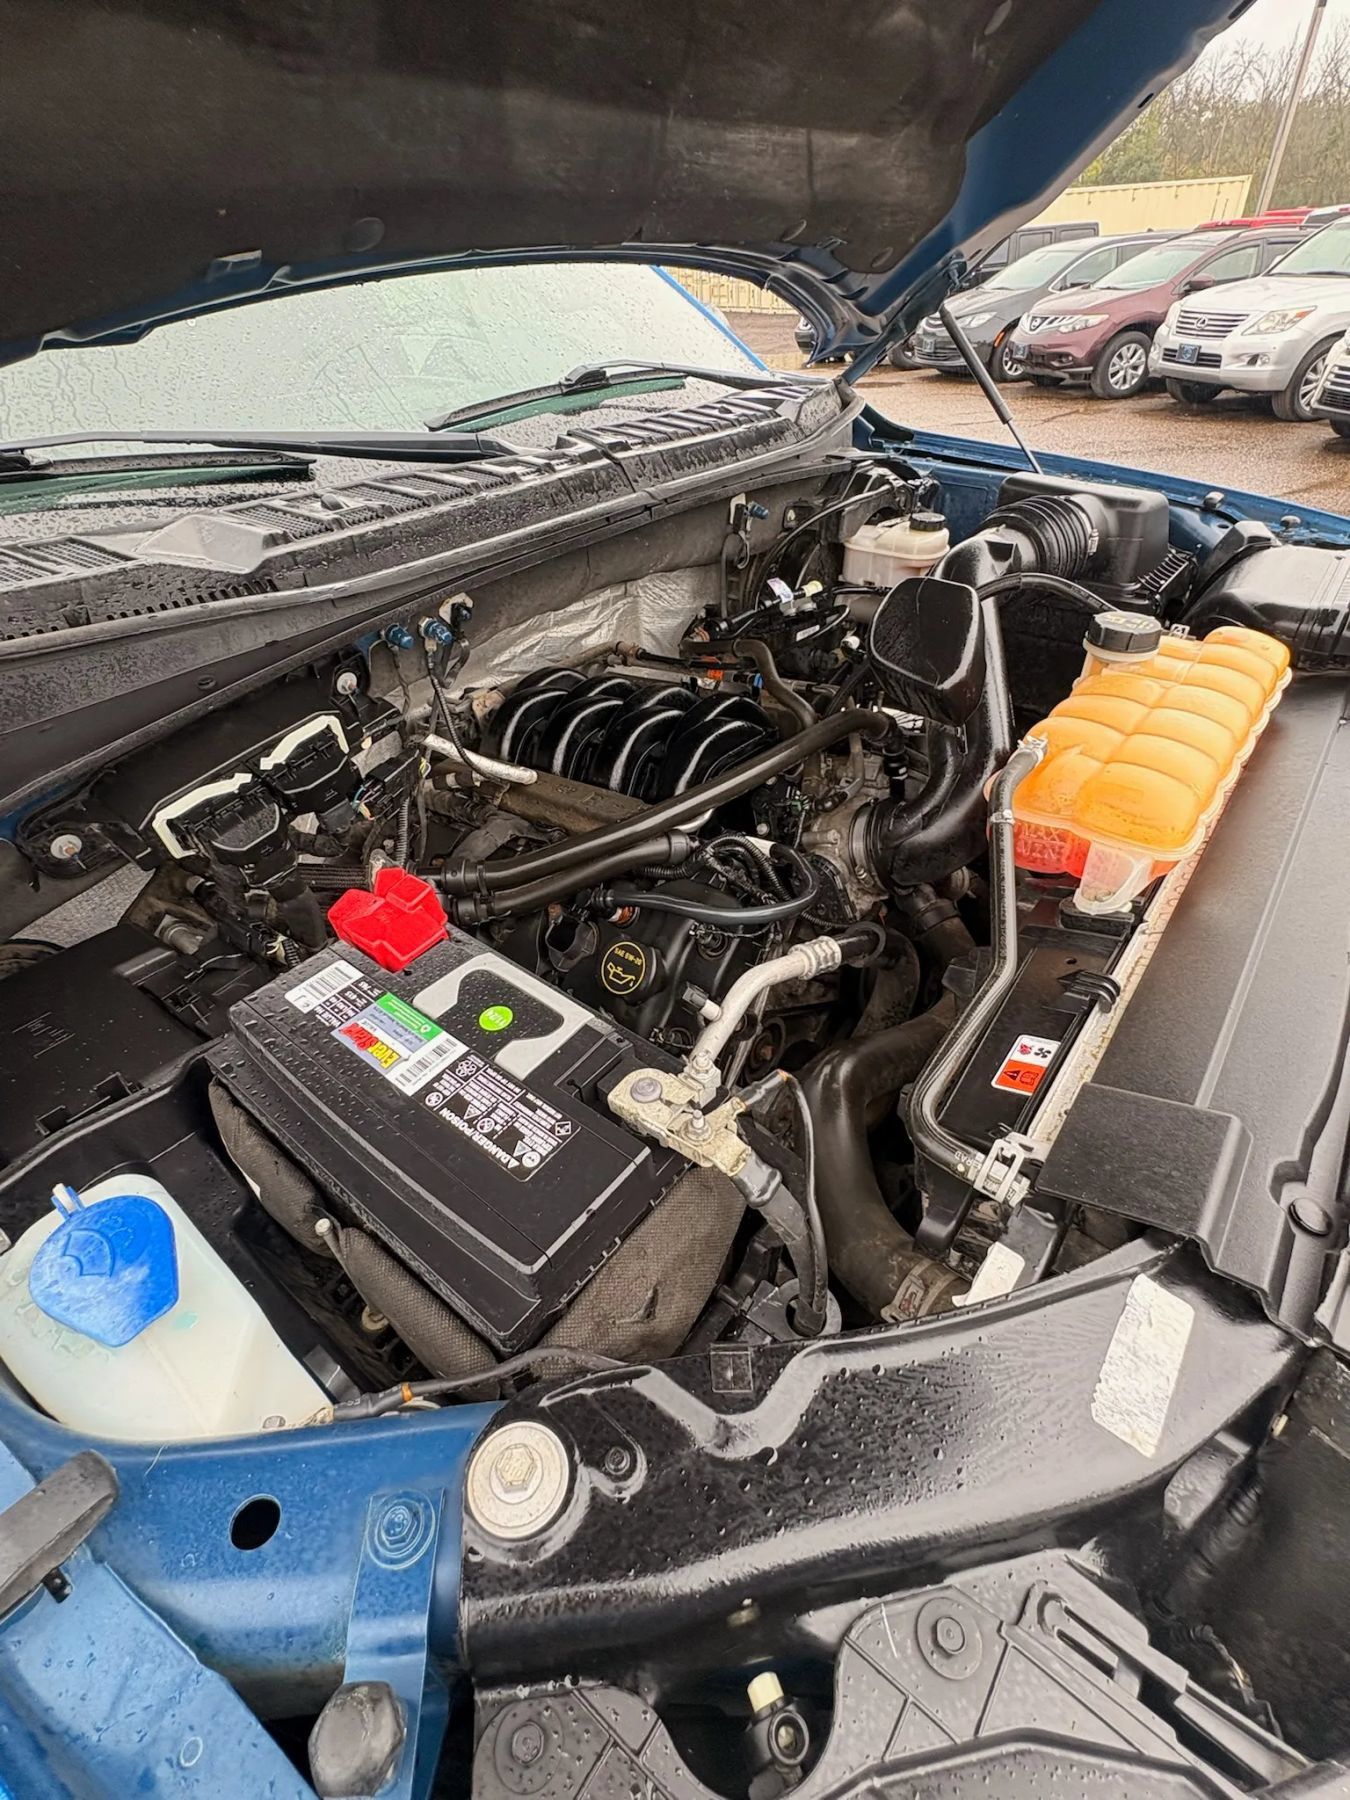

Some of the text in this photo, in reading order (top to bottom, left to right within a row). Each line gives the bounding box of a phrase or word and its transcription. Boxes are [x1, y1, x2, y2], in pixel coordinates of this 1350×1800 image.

[614, 947, 625, 958] SAE
[320, 1010, 342, 1027] VALUE
[338, 1021, 402, 1069] EverStart
[438, 1106, 512, 1164] DANGER/POISON
